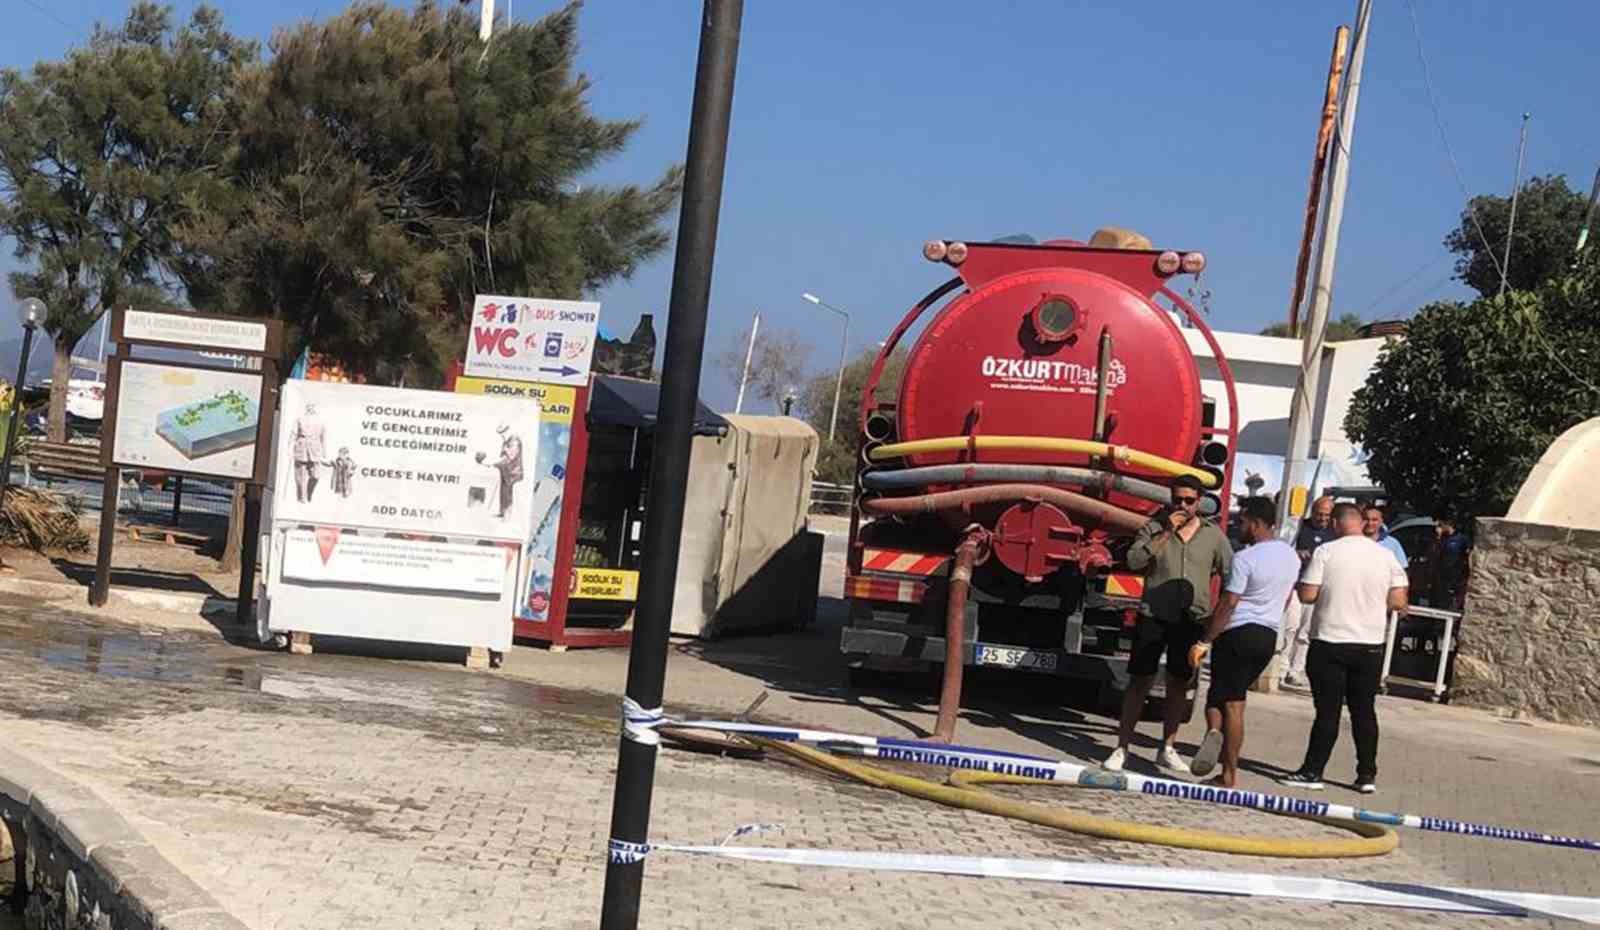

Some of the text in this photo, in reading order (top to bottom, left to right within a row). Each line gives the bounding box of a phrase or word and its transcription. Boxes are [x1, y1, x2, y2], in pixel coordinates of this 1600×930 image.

[474, 326, 519, 358] WC
[484, 384, 547, 398] SOĞUK SU
[361, 421, 378, 431] VE
[417, 472, 460, 484] HAYIR!
[371, 505, 397, 516] ADD
[983, 649, 999, 662] 25
